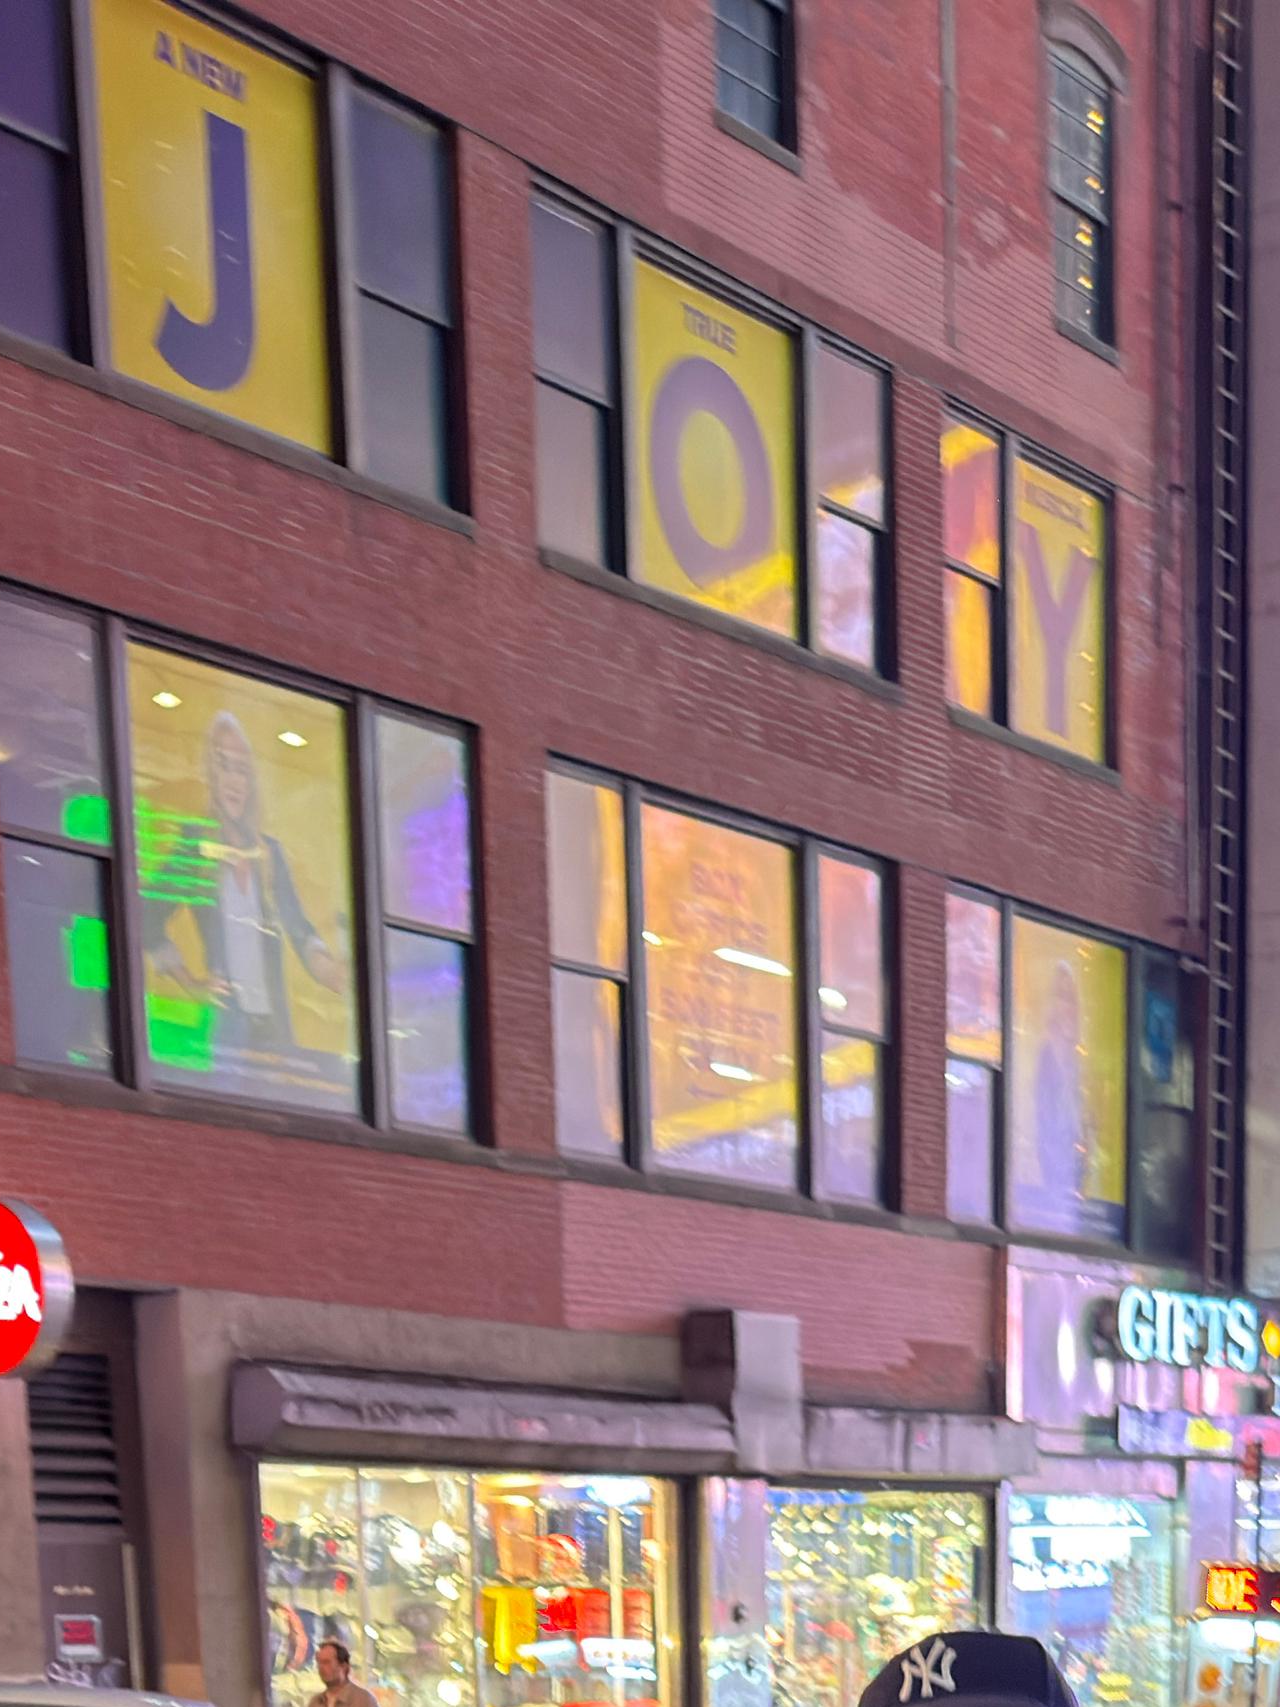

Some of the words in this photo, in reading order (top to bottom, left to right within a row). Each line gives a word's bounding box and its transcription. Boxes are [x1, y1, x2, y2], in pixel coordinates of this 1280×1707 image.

[154, 29, 176, 69] A
[179, 41, 248, 103] NEW
[1118, 1285, 1259, 1373] GIFTS
[899, 1637, 957, 1702] NY
